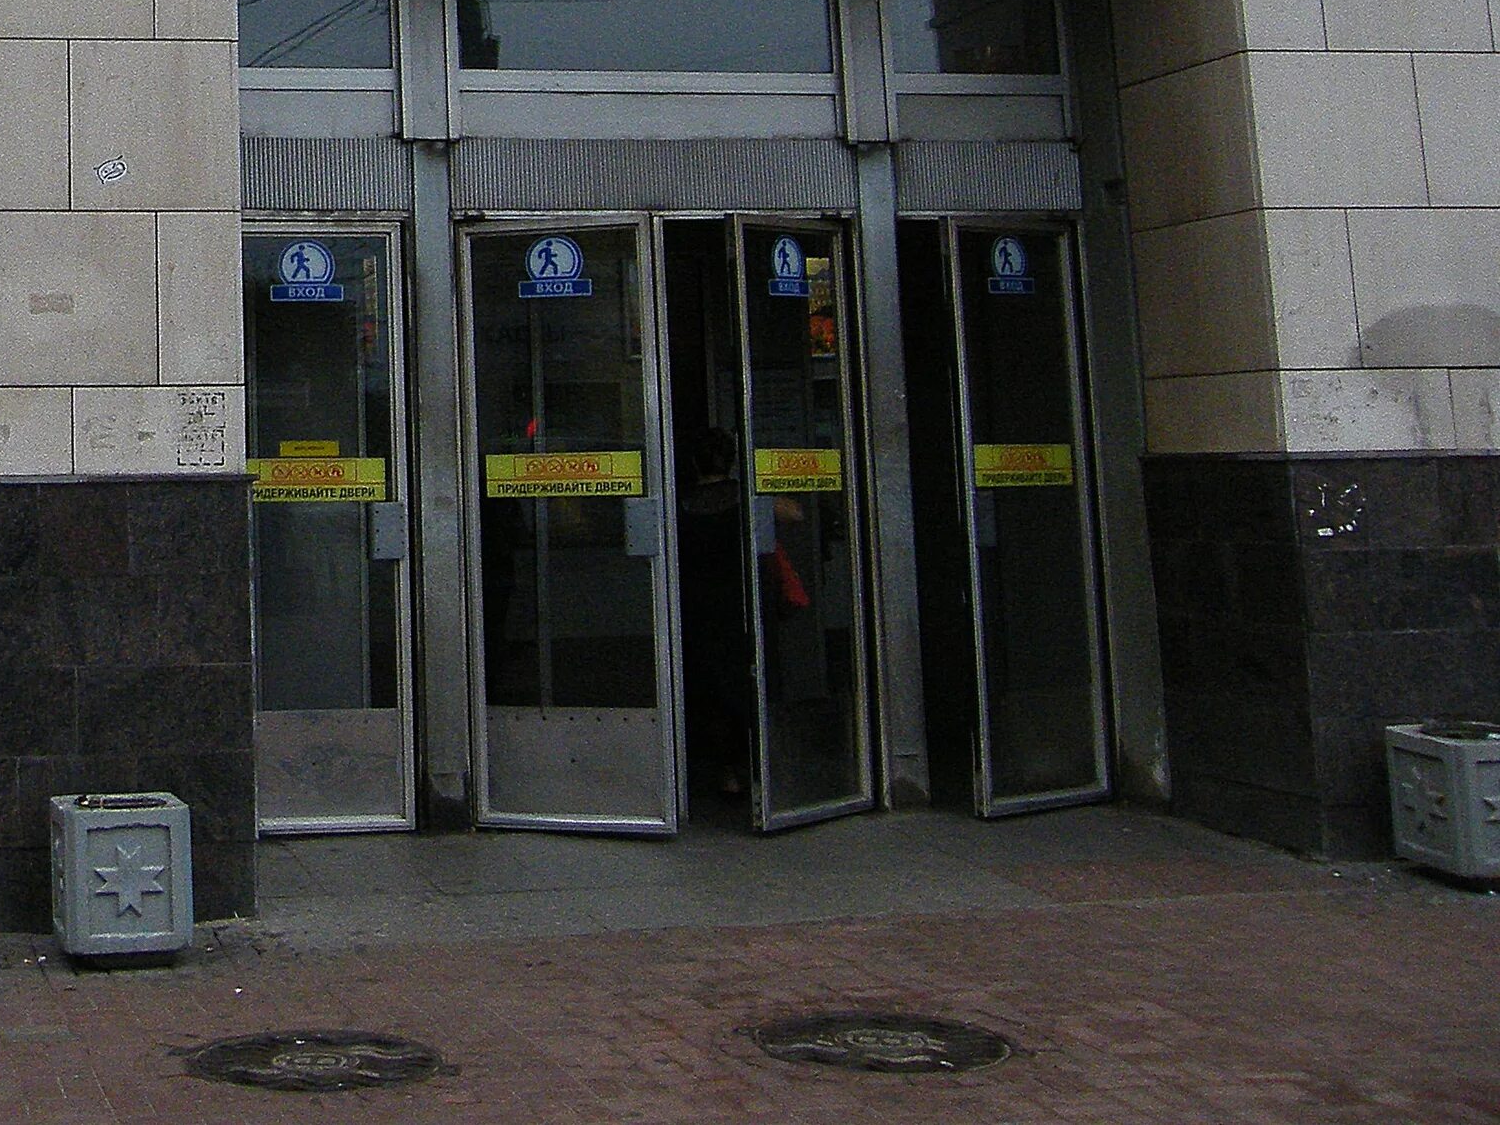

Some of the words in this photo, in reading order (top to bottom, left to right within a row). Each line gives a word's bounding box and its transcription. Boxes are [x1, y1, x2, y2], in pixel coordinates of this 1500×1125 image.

[288, 286, 325, 299] ВХОД
[536, 282, 573, 294] ВХОД
[339, 486, 375, 498] ДВЕРИ
[497, 482, 592, 494] ПРИДЕРЖИВАЙТЕ
[595, 481, 632, 494] ДВЕРИ
